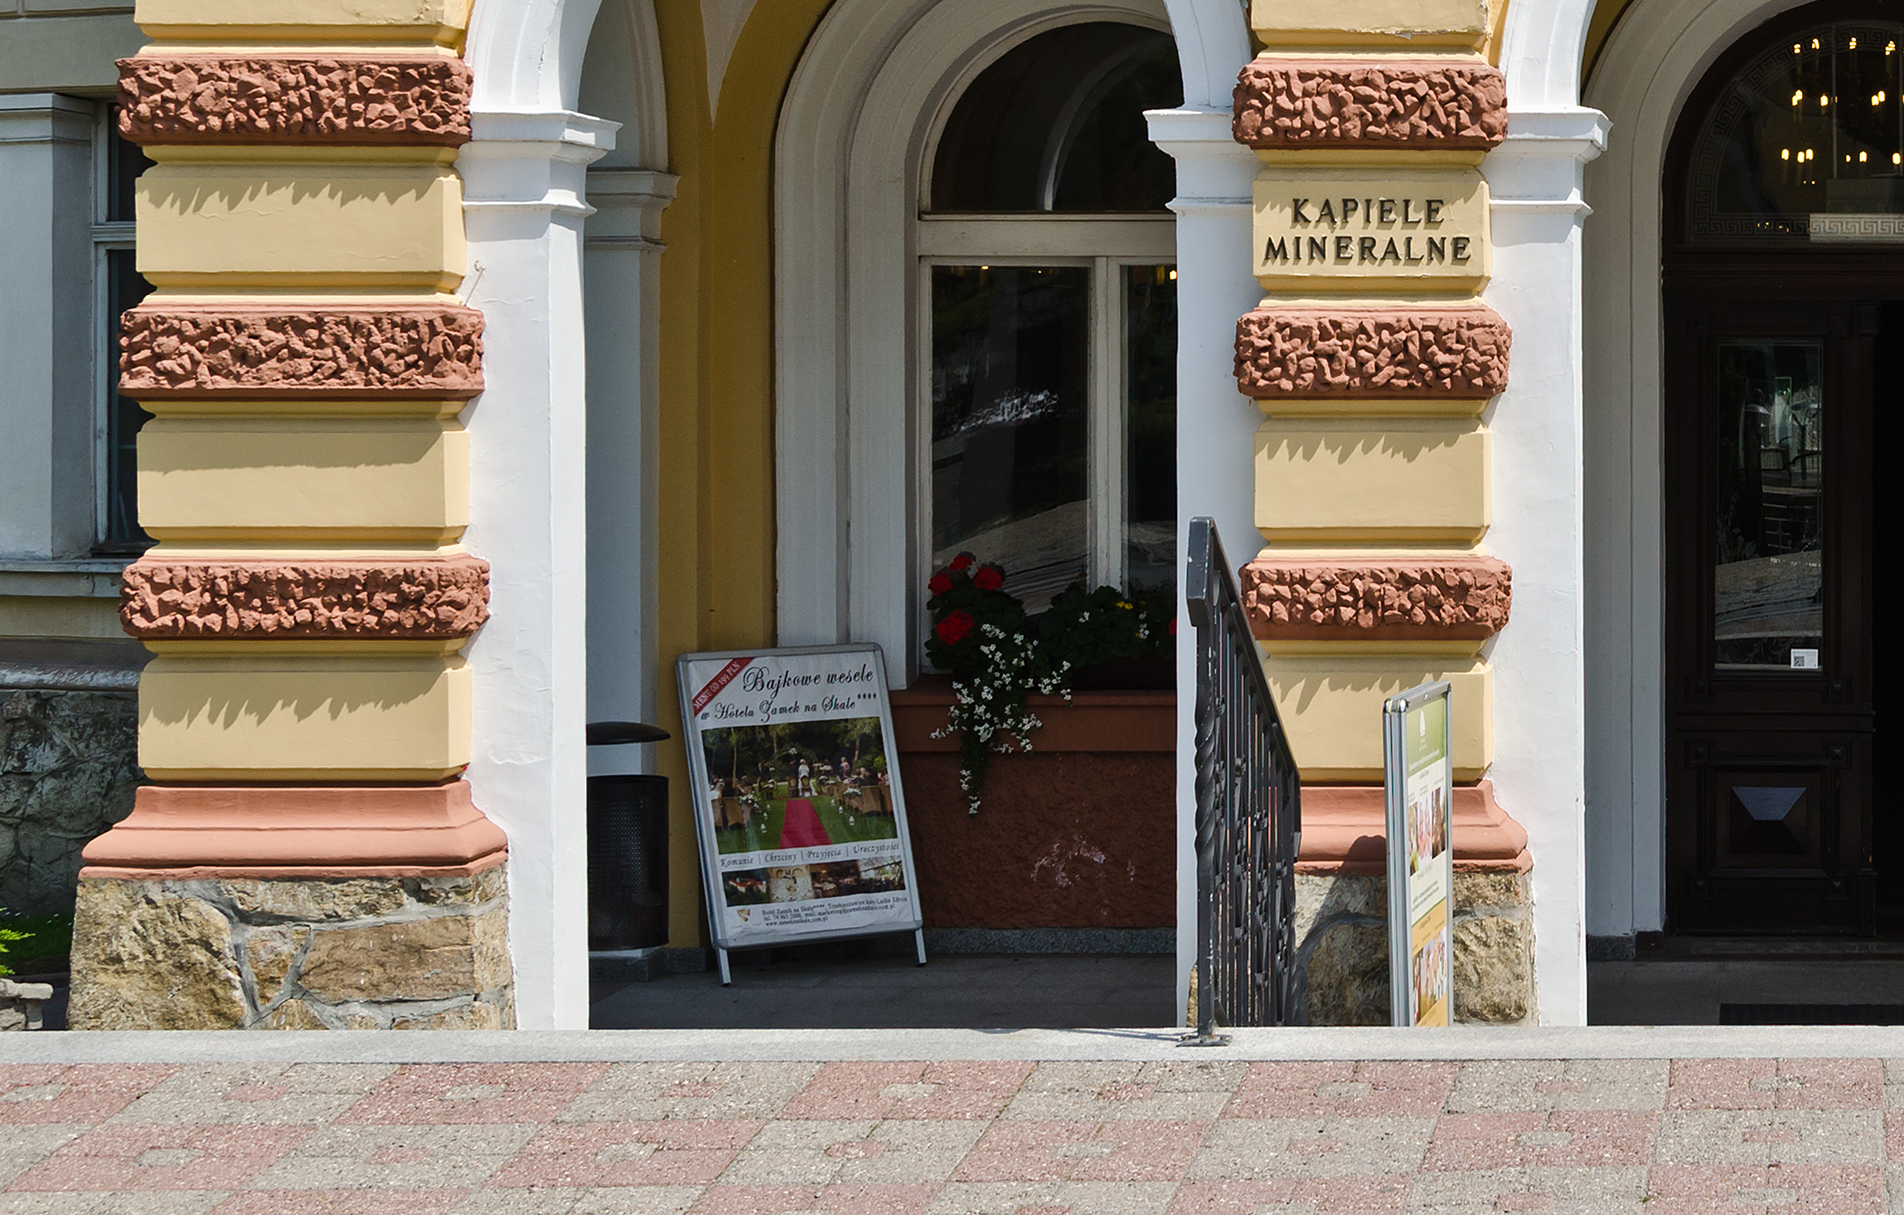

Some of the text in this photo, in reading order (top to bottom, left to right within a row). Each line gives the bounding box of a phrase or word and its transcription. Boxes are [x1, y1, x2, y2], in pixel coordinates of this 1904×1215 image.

[1264, 236, 1472, 261] MINERALNE
[693, 688, 713, 710] MENU
[710, 681, 720, 693] OD
[728, 661, 741, 676] PLN
[742, 663, 874, 699] Bajkowe wesele
[804, 704, 817, 713] na
[719, 856, 755, 868] Komunie
[764, 851, 798, 865] Chrzciny
